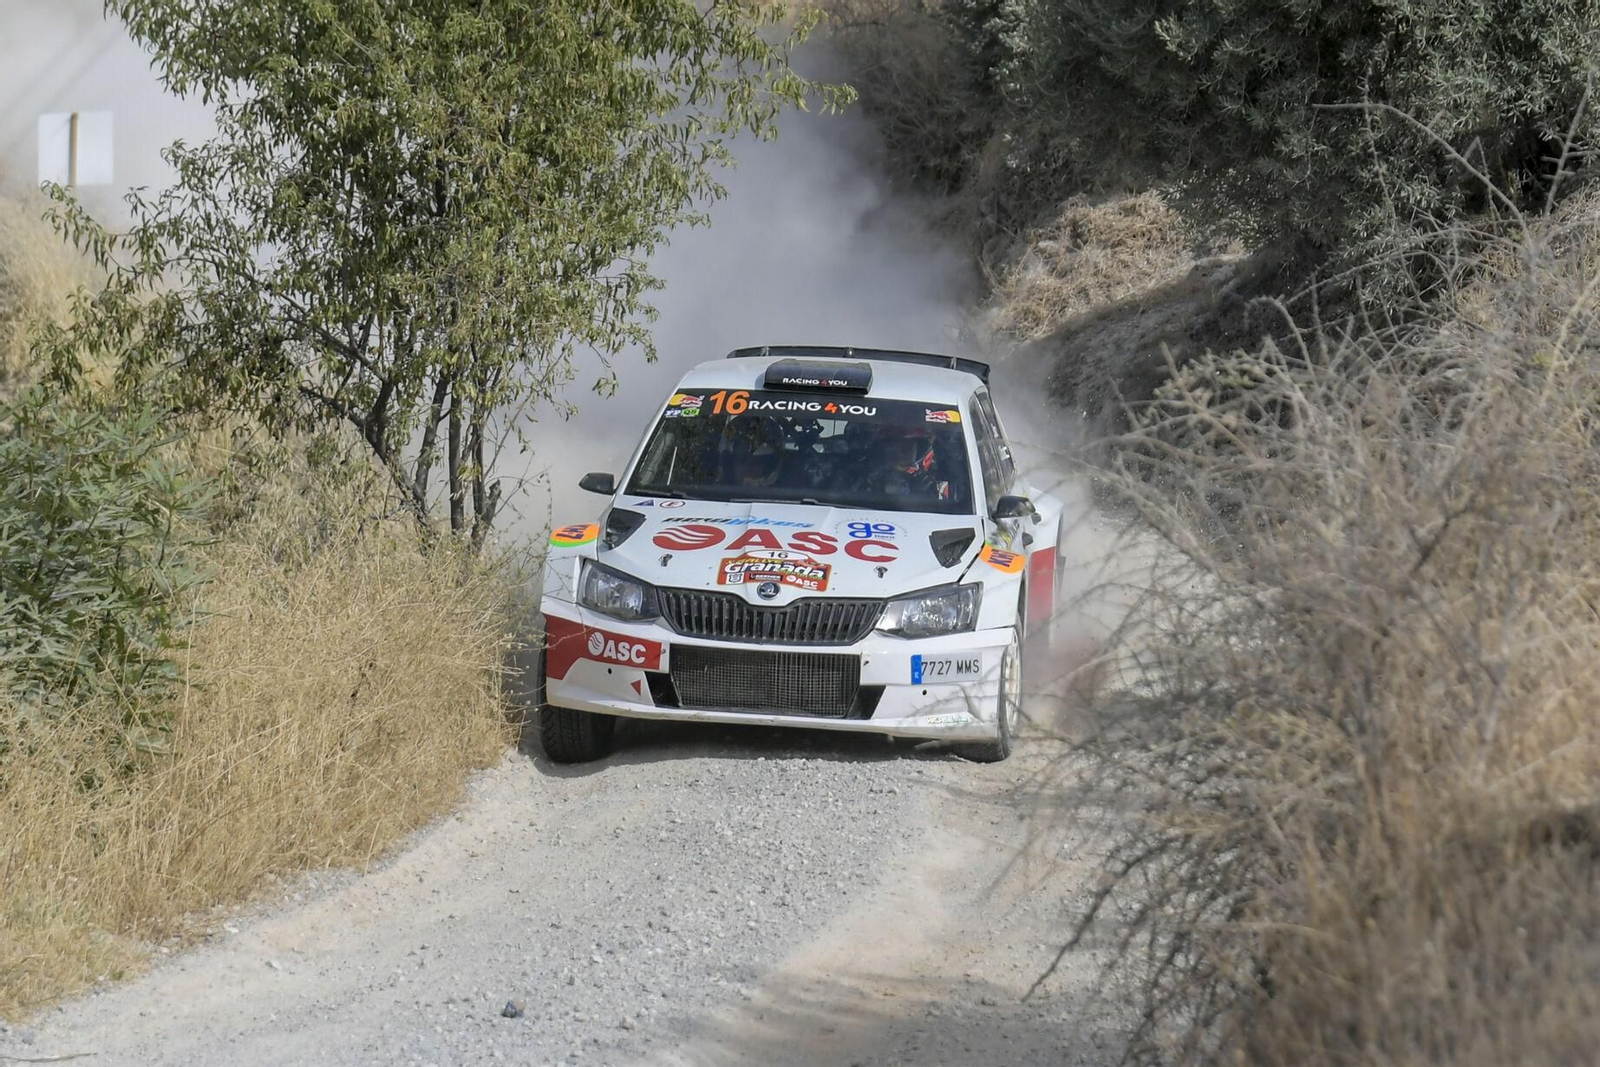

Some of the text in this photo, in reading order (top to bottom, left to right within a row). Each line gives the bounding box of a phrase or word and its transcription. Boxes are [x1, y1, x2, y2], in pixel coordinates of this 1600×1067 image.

[782, 377, 820, 385] RACING
[709, 390, 750, 415] 16
[748, 400, 877, 416] RACING 4 YOU
[847, 521, 896, 539] go
[724, 528, 900, 563] ASC
[766, 551, 789, 559] 16
[724, 561, 825, 578] Granada
[795, 578, 819, 588] ASC
[602, 639, 647, 664] ASC
[920, 659, 981, 677] 7727 MMS
